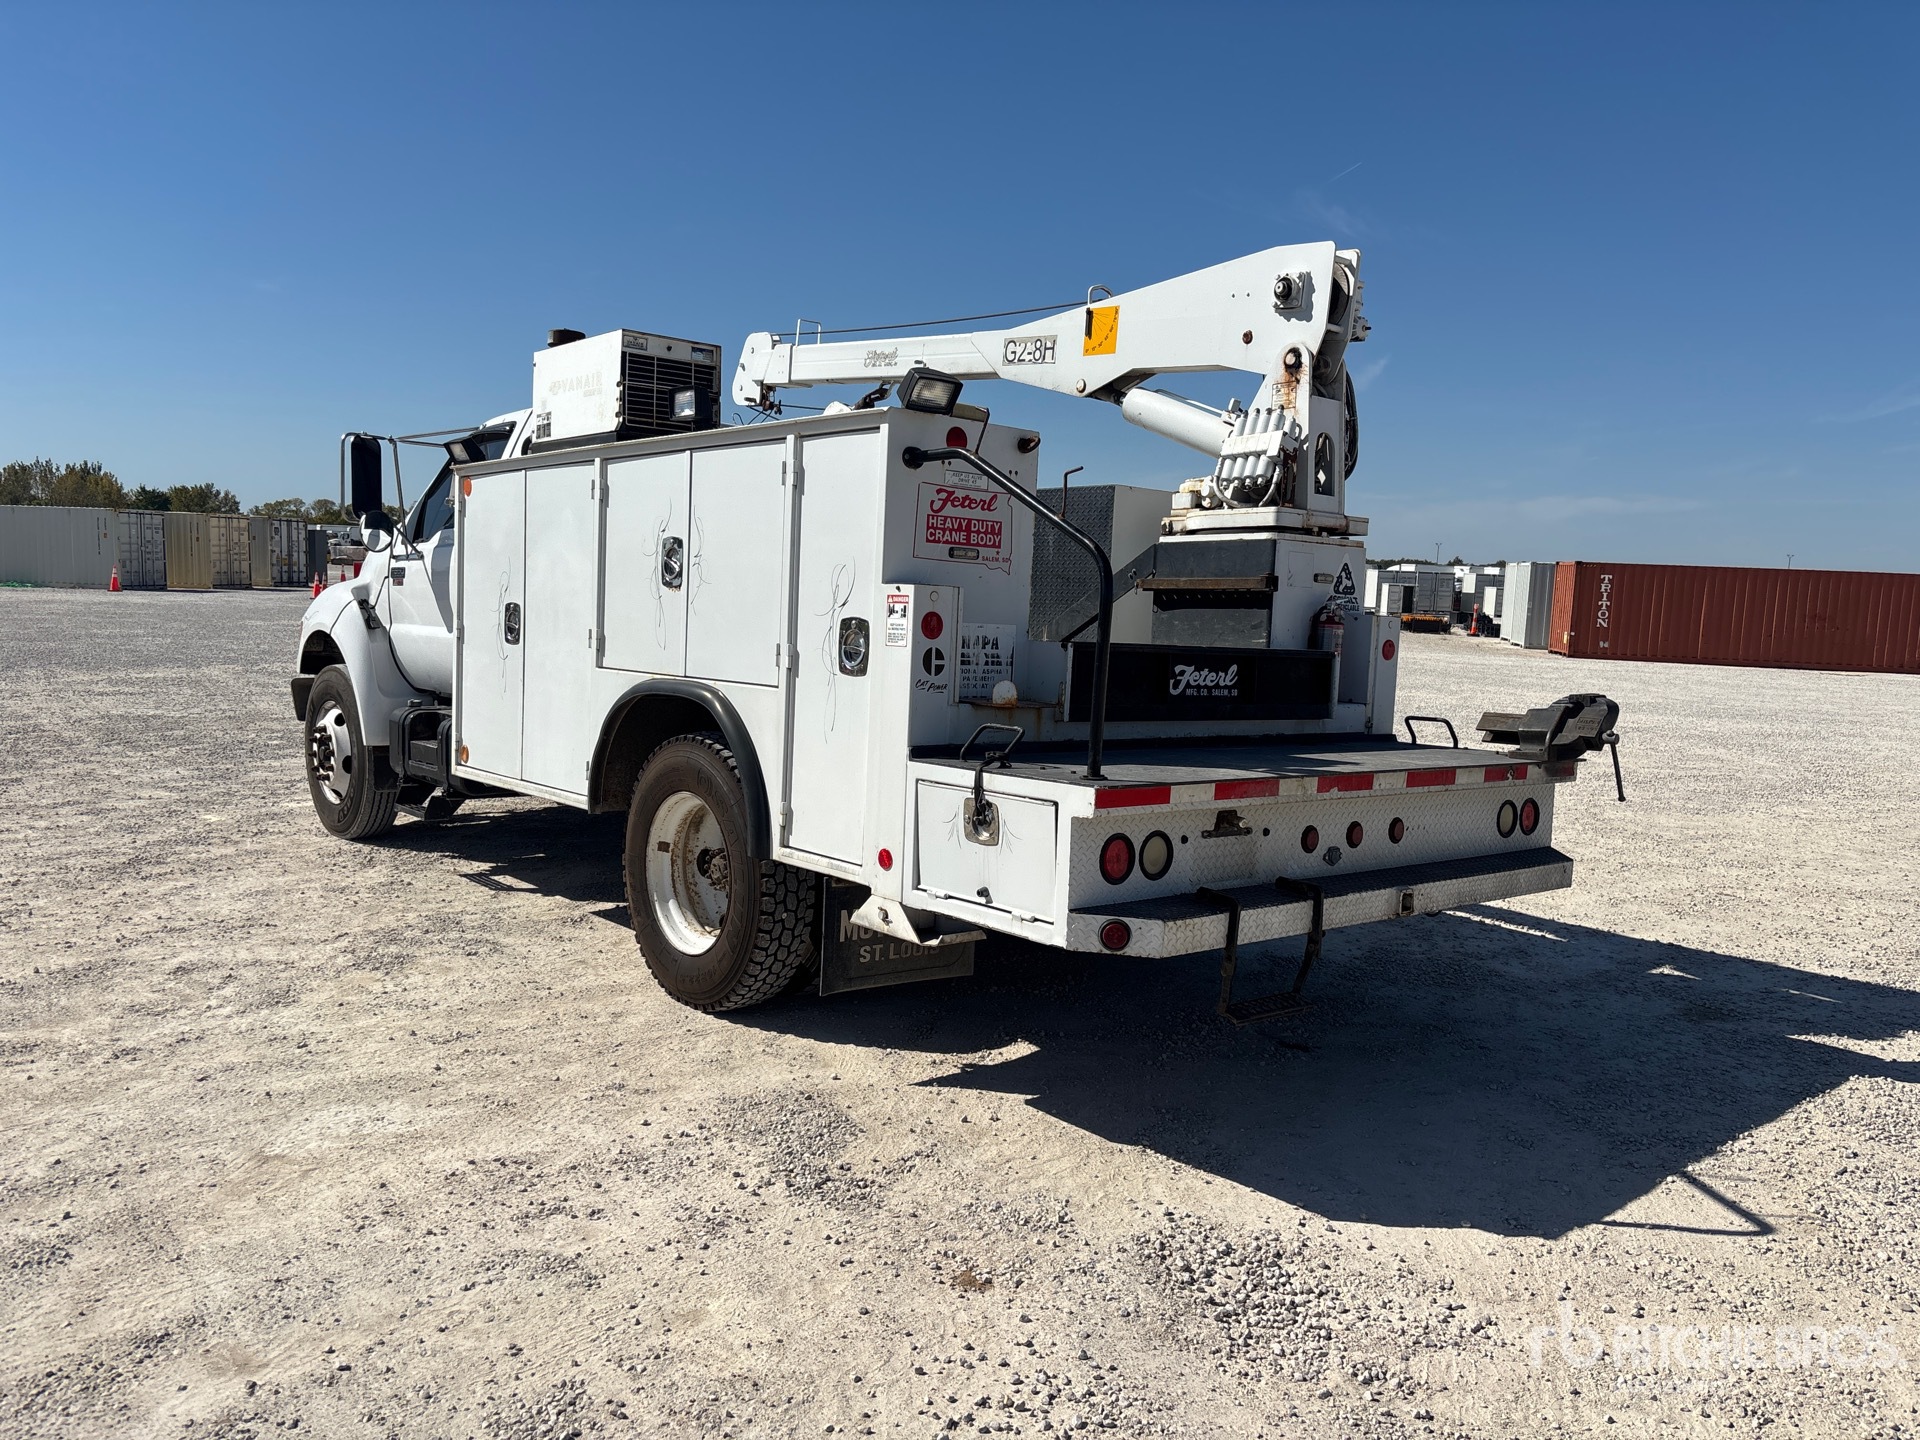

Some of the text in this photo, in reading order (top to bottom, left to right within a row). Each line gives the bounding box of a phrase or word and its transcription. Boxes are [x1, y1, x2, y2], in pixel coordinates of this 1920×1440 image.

[1004, 338, 1056, 363] G2-8H
[929, 487, 998, 514] Feterl
[929, 515, 1001, 533] HEAVY DUTY
[927, 529, 1001, 546] CRANE BODY
[1596, 574, 1613, 628] TRITON
[914, 678, 949, 693] CAT POWER
[1169, 663, 1238, 696] Feterl
[859, 943, 885, 963] ST.
